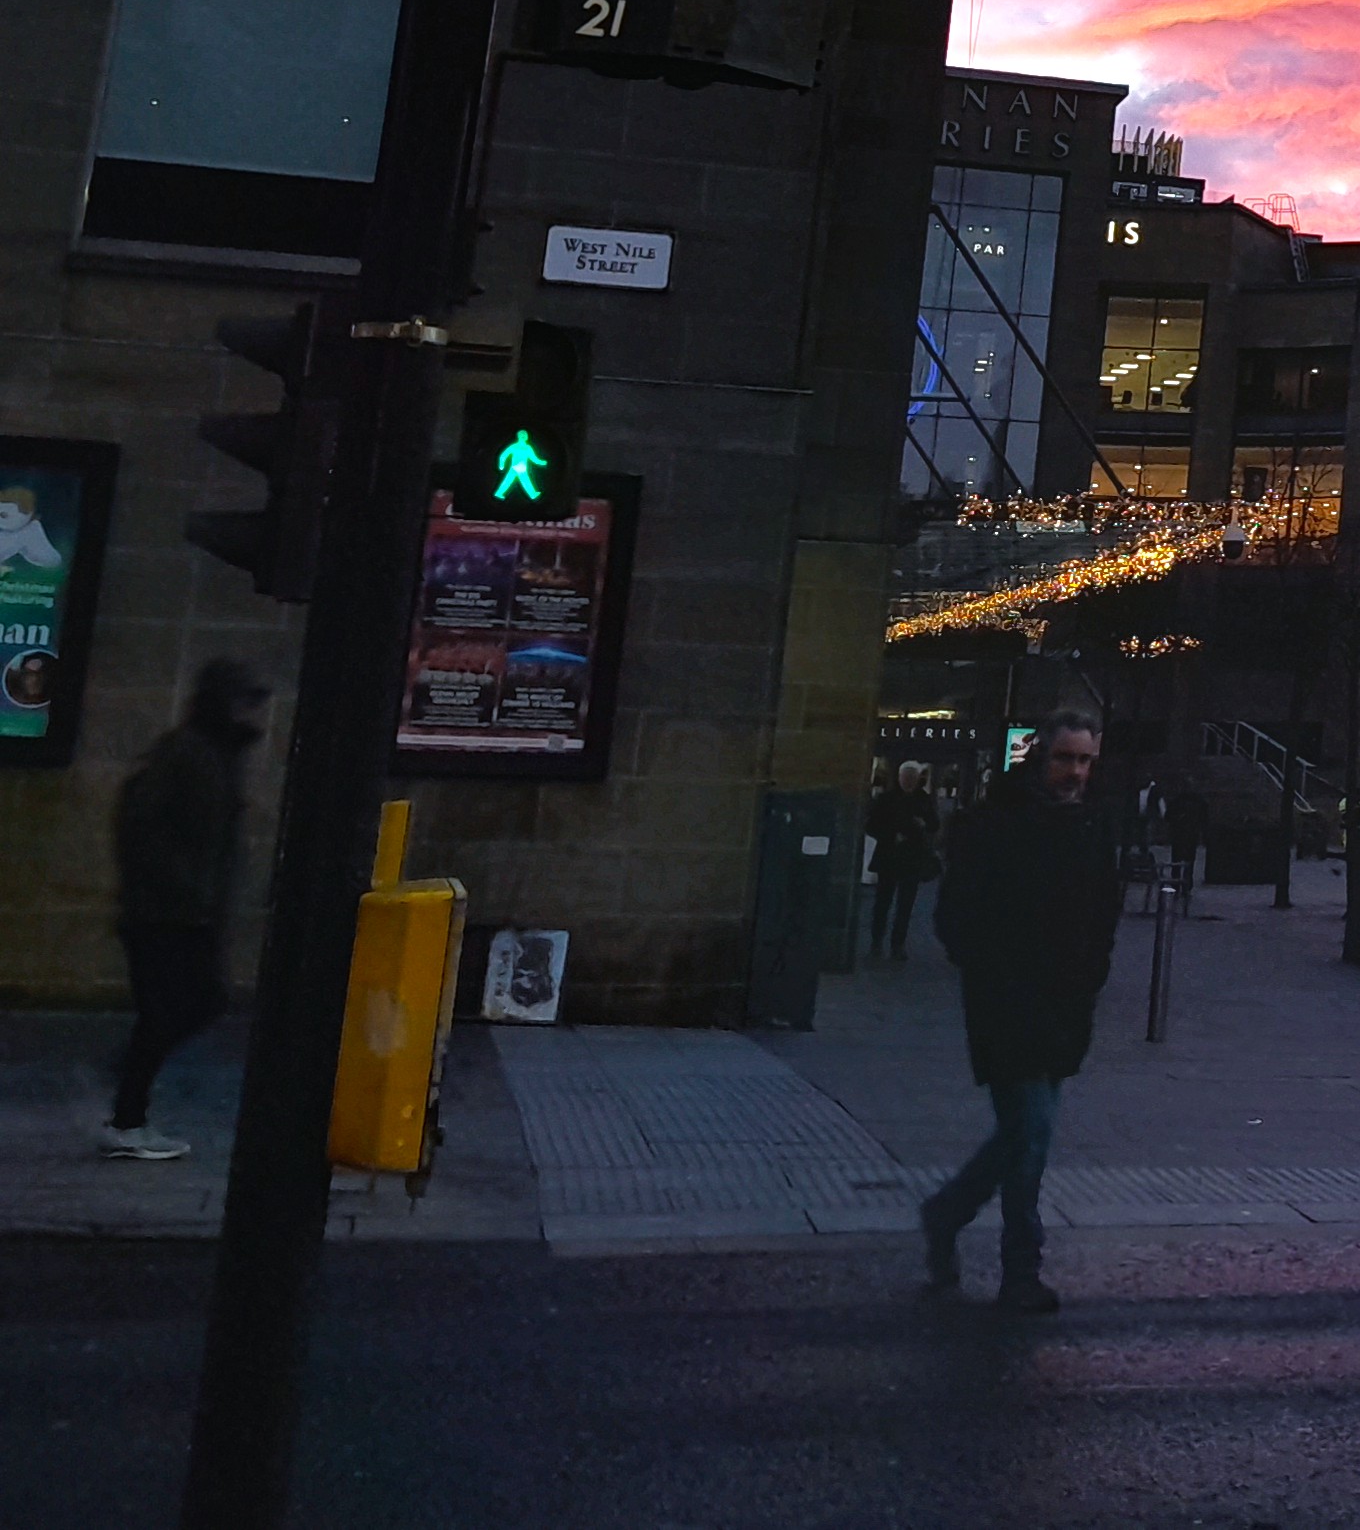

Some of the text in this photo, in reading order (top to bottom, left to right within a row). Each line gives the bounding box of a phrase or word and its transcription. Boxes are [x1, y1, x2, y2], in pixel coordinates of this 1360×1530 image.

[563, 237, 656, 260] WEST NILE
[575, 254, 638, 274] STREET
